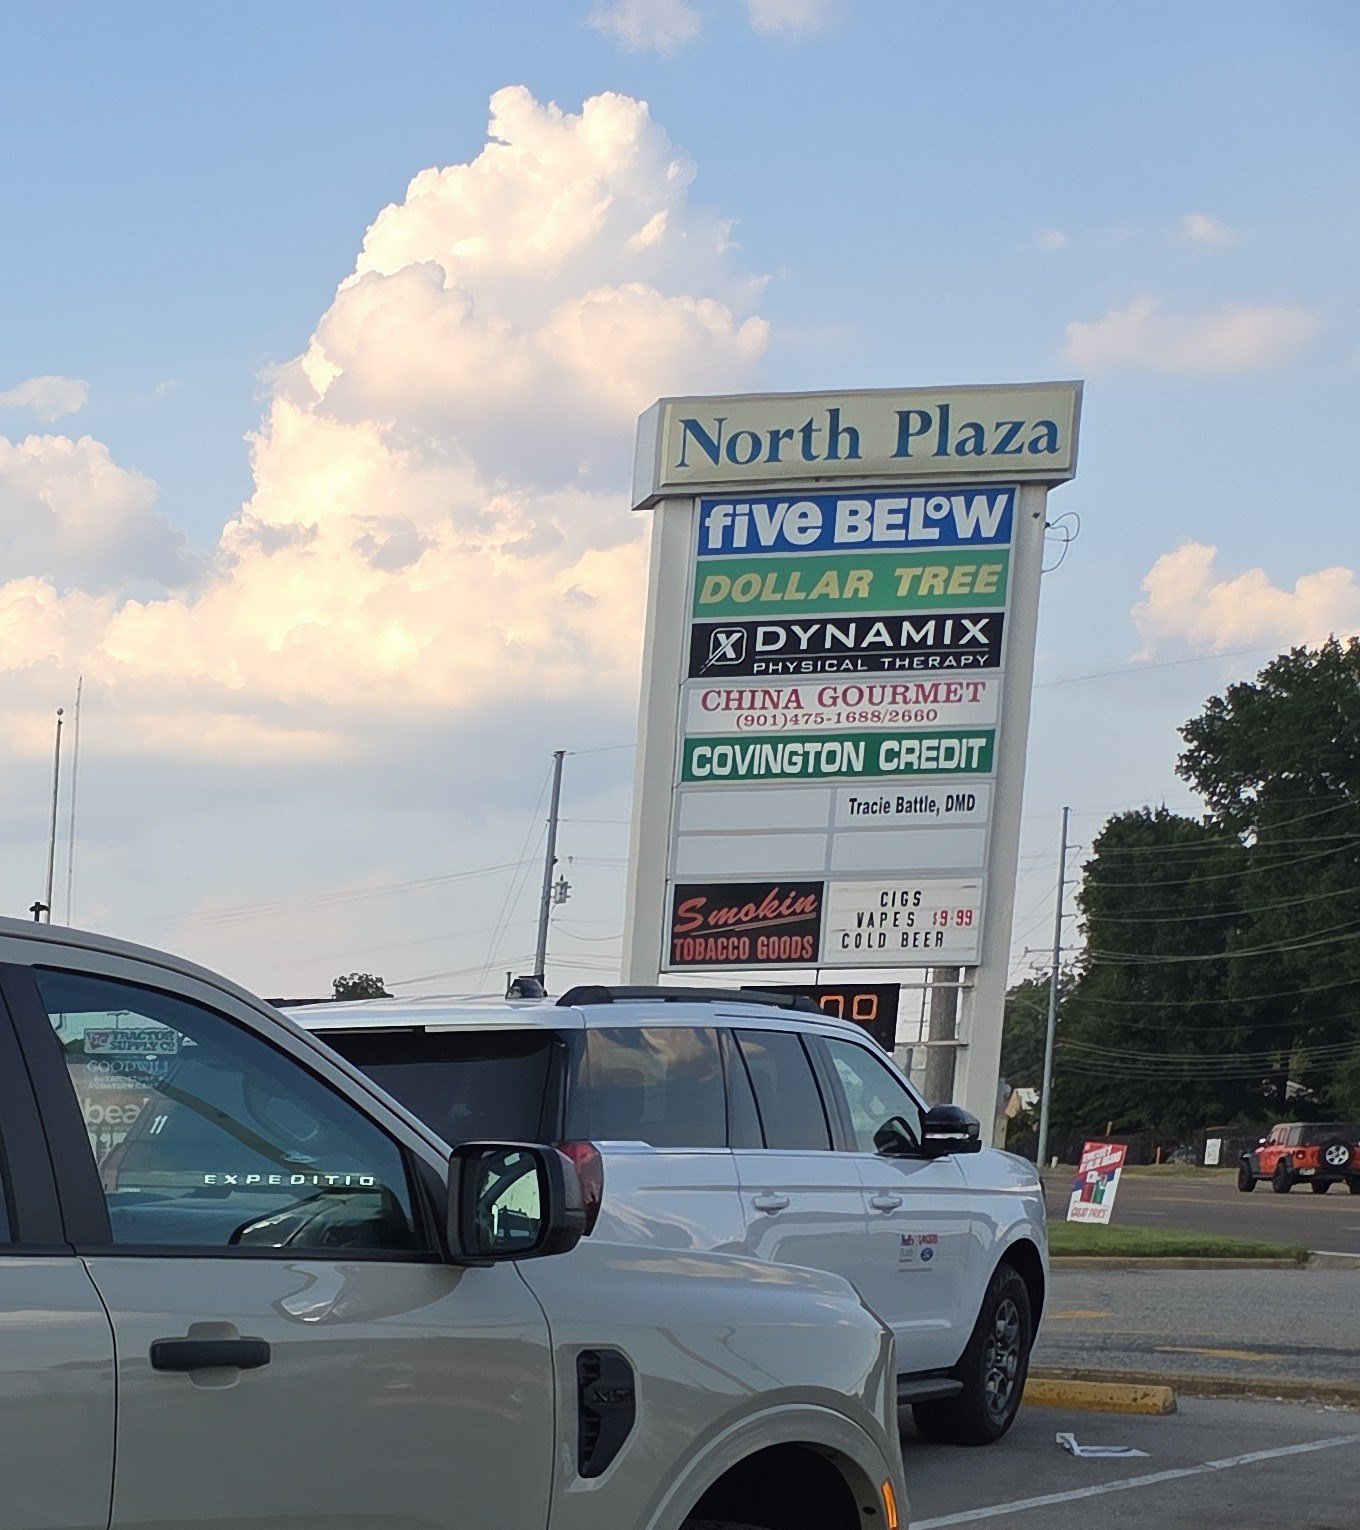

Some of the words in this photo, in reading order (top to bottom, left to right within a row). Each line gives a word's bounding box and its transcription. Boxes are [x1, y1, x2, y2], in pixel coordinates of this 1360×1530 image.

[674, 407, 862, 469] North
[890, 404, 1061, 460] Plaza
[704, 500, 823, 549] five
[698, 568, 874, 605] DOLLAR
[894, 564, 1003, 597] TREE
[755, 618, 990, 652] DYNAMIX
[753, 658, 869, 675] PHYSICAL
[880, 654, 989, 670] THERAPY
[701, 688, 804, 712] CHINA
[817, 681, 986, 708] GOURMET
[691, 741, 865, 777] COVINGTON
[879, 738, 986, 771] CREDIT
[848, 797, 891, 815] Tracie
[895, 795, 940, 817] Battle,
[945, 794, 976, 812] DMD
[674, 886, 818, 933] Smokin
[880, 890, 922, 908] CIGS
[856, 912, 916, 928] VAPES
[674, 937, 749, 961] TOBACCO
[757, 935, 813, 960] GOODS
[841, 932, 887, 949] COLD
[900, 931, 944, 948] BEER
